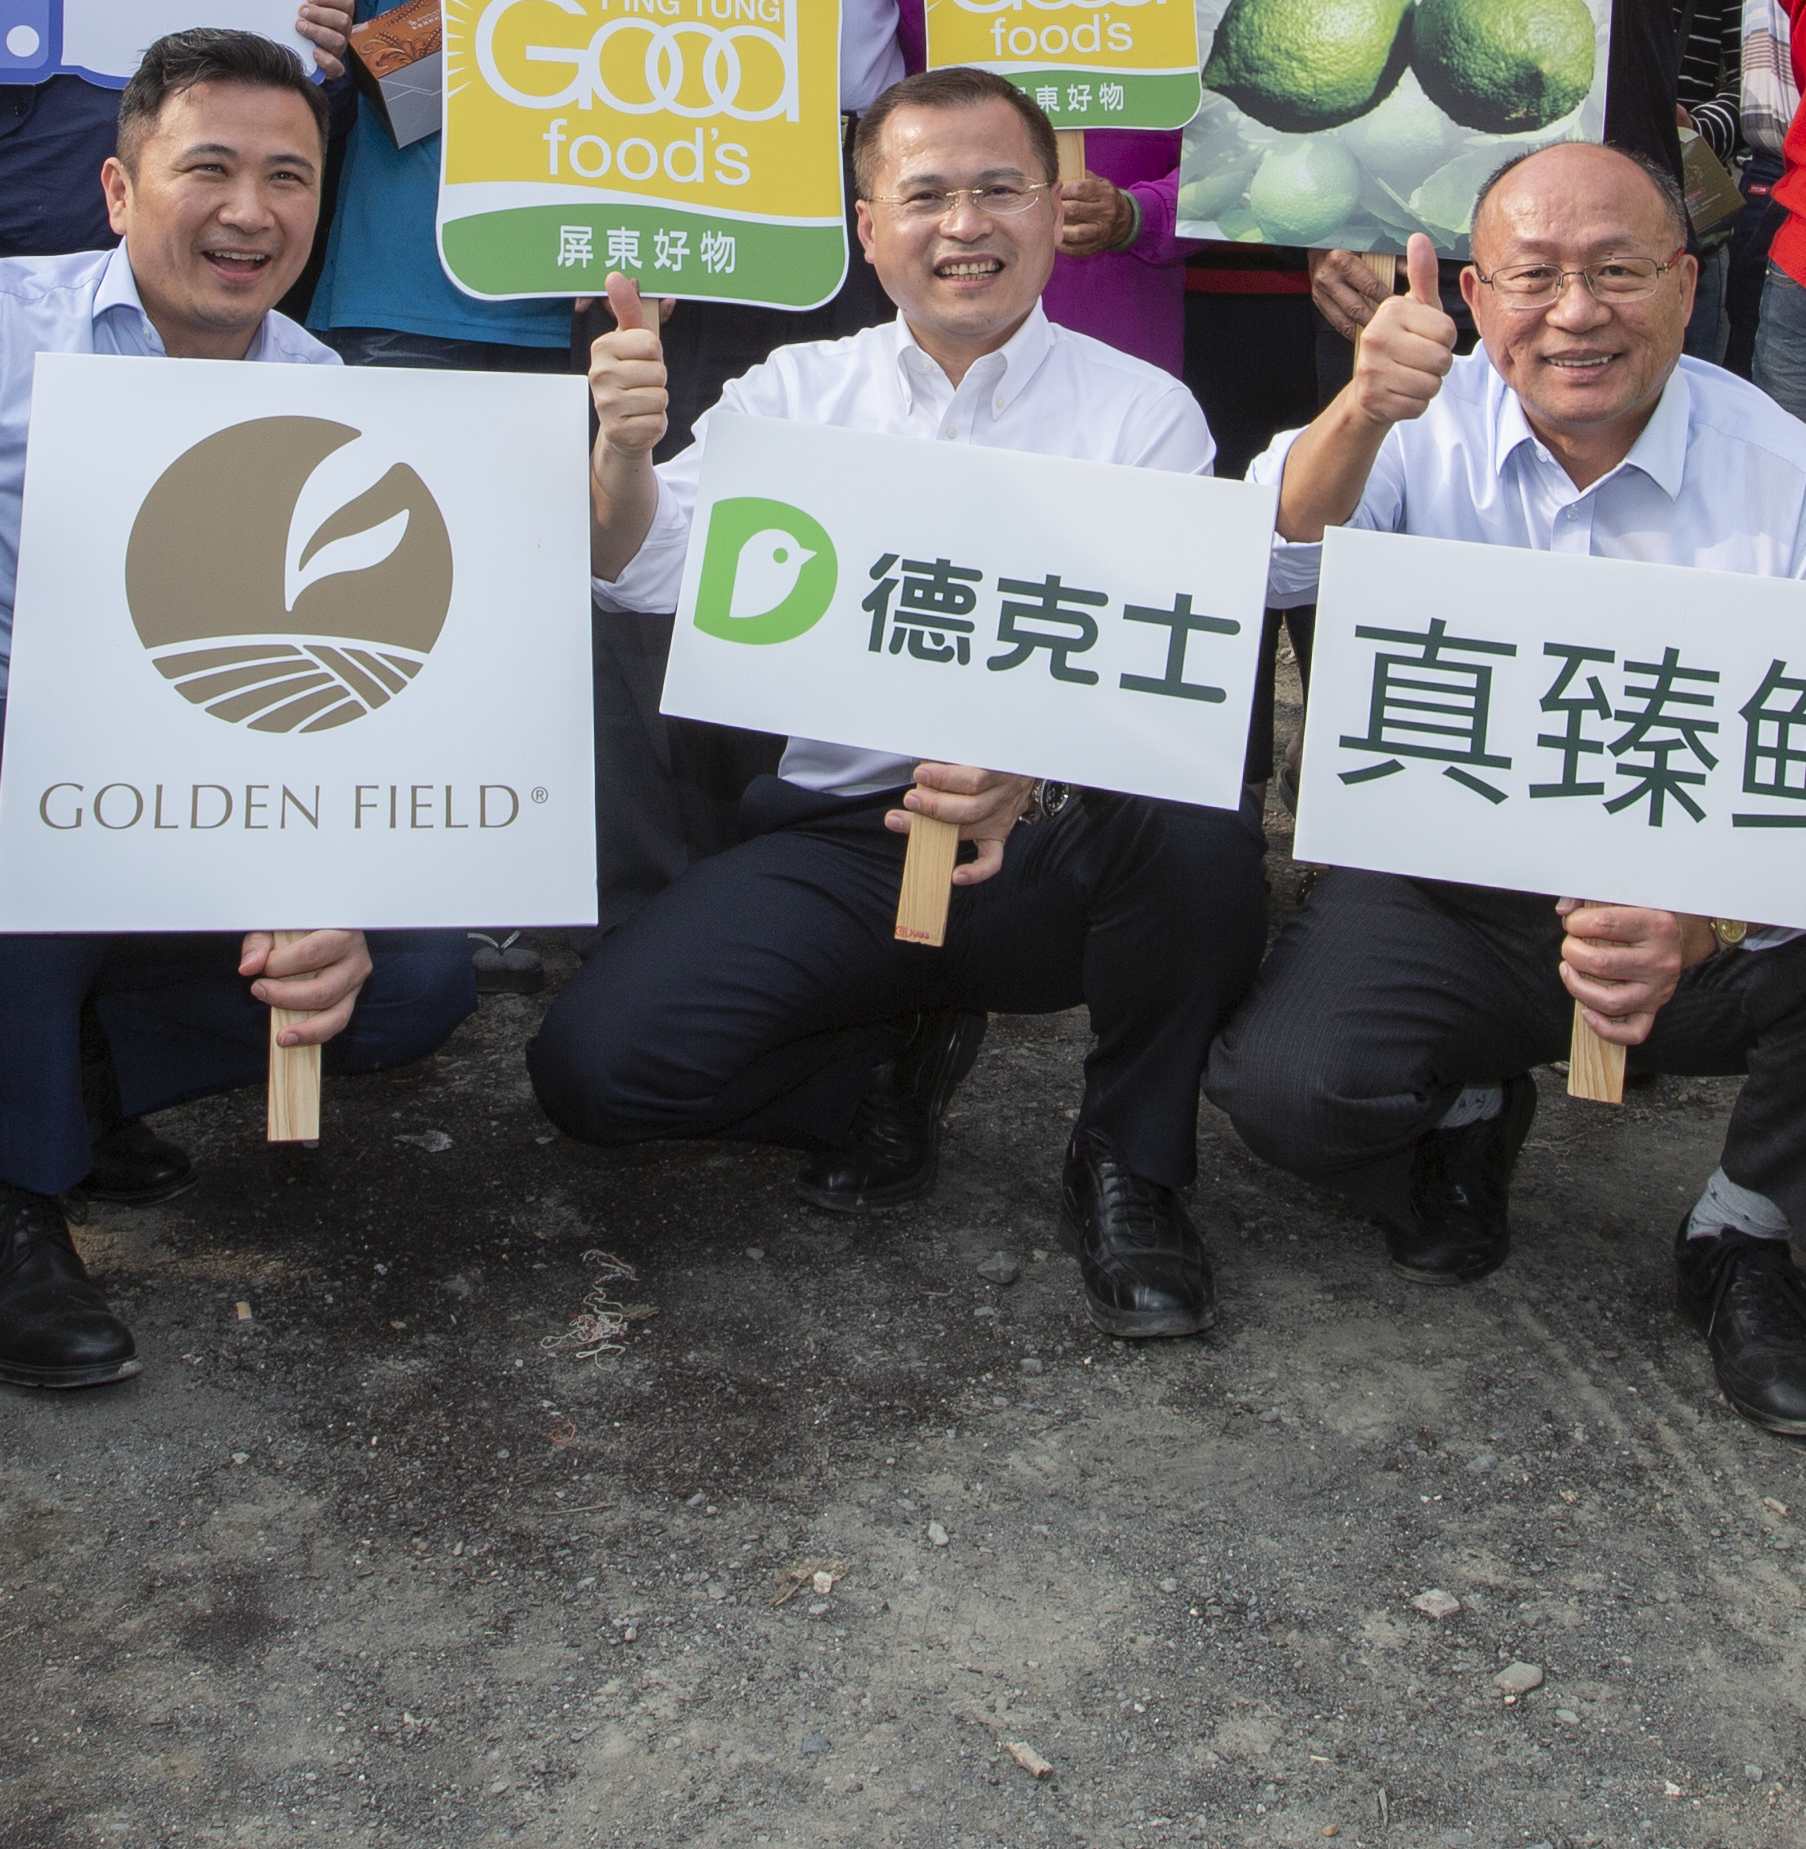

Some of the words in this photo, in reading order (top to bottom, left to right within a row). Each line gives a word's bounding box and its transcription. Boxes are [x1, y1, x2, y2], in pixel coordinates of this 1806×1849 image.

[990, 13, 1133, 56] food's
[1017, 82, 1124, 113] 東好物
[542, 118, 751, 186] food's
[556, 224, 737, 274] 屏東好物
[861, 552, 1242, 704] 德克士
[39, 782, 321, 831] GOLDEN
[354, 784, 520, 830] FIELD
